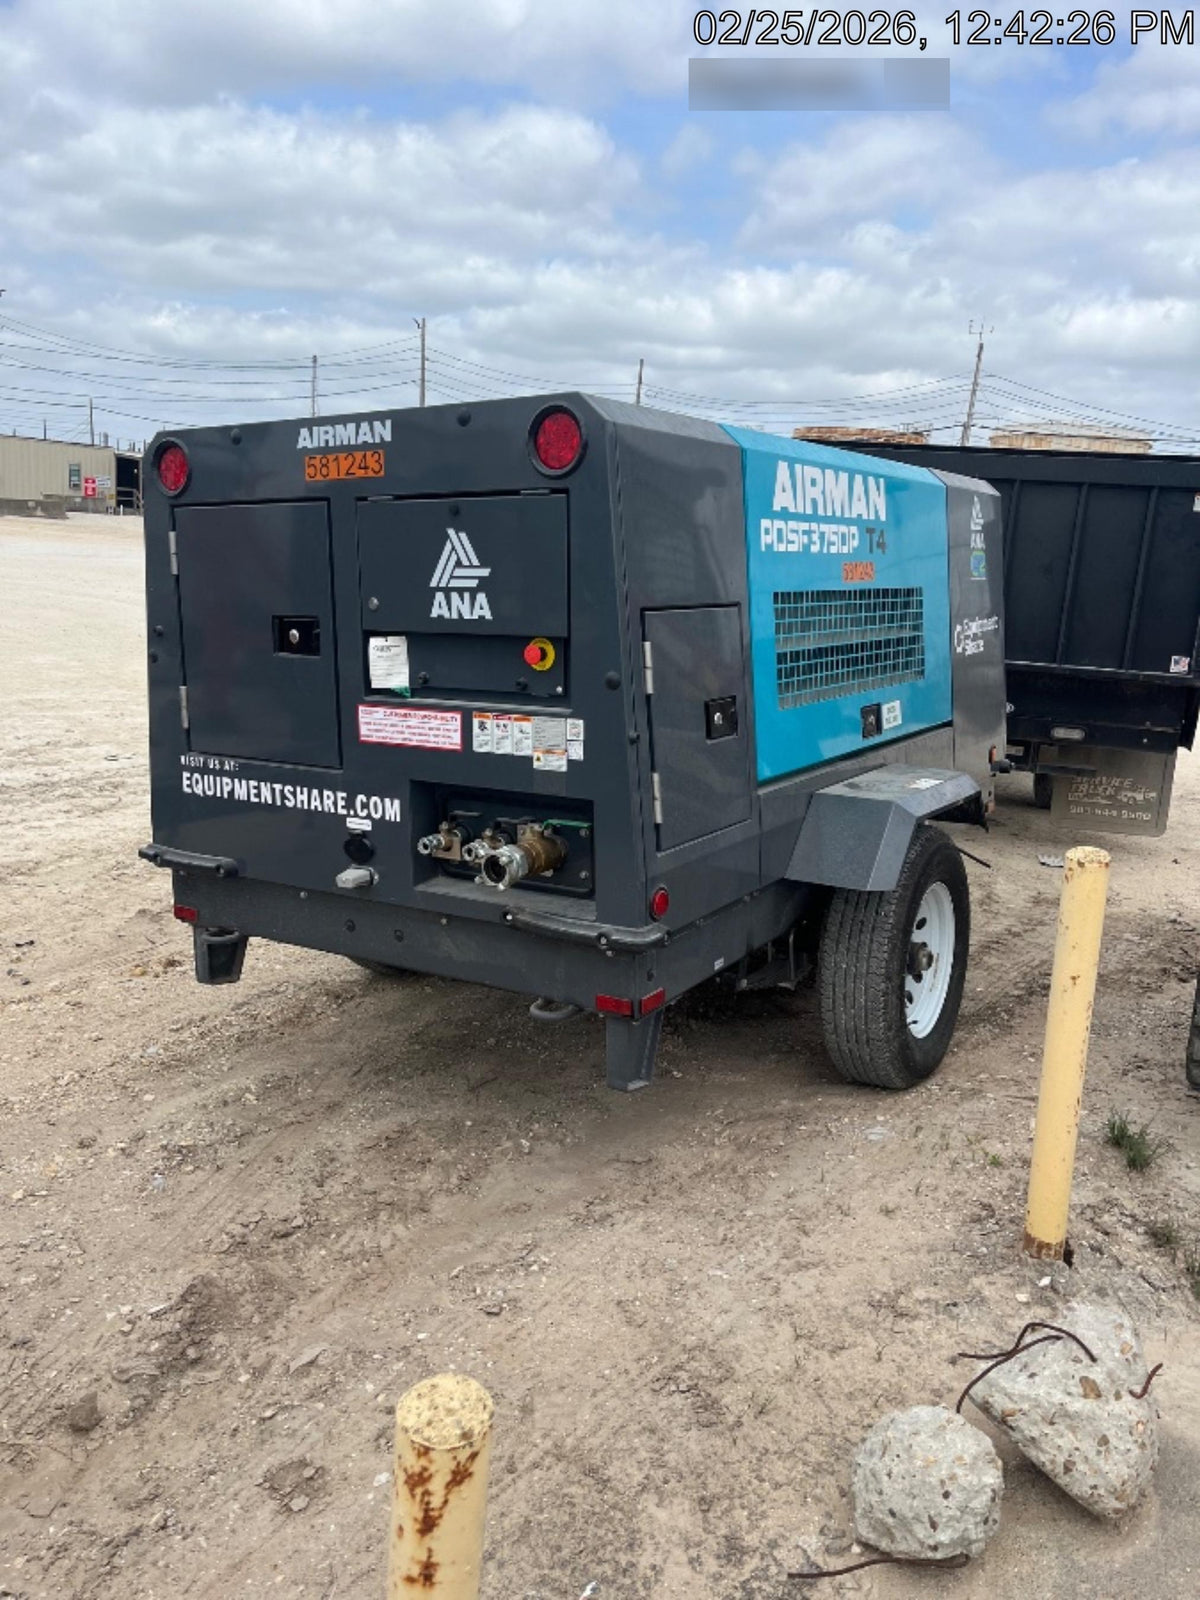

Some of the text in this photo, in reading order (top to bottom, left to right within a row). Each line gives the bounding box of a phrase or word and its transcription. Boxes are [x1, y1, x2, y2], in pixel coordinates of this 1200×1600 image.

[296, 419, 392, 449] AIRMAN
[306, 451, 383, 479] 581243
[772, 460, 887, 522] AIRMAN
[865, 527, 887, 555] T4
[429, 591, 494, 620] ANA
[180, 754, 204, 769] VISIT
[207, 757, 221, 771] US
[181, 771, 402, 823] EQUIPMENTSHARE.COM
